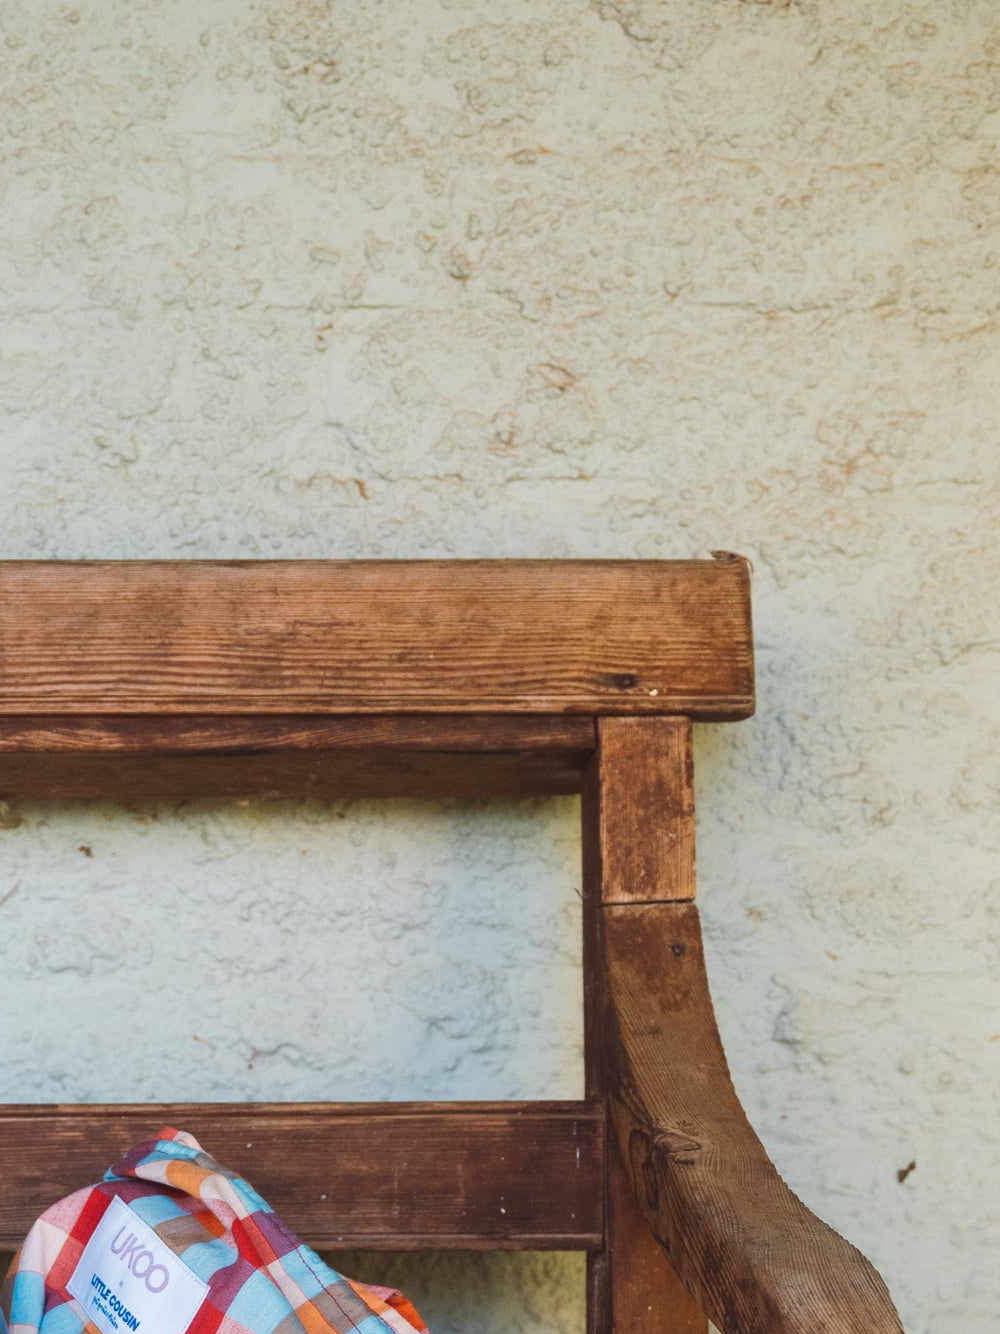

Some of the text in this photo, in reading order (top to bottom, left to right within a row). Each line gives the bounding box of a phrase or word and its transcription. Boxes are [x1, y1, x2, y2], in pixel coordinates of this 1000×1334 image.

[110, 1226, 170, 1294] UKOO
[90, 1273, 110, 1302] LITTLE
[108, 1295, 141, 1332] COUSIN
